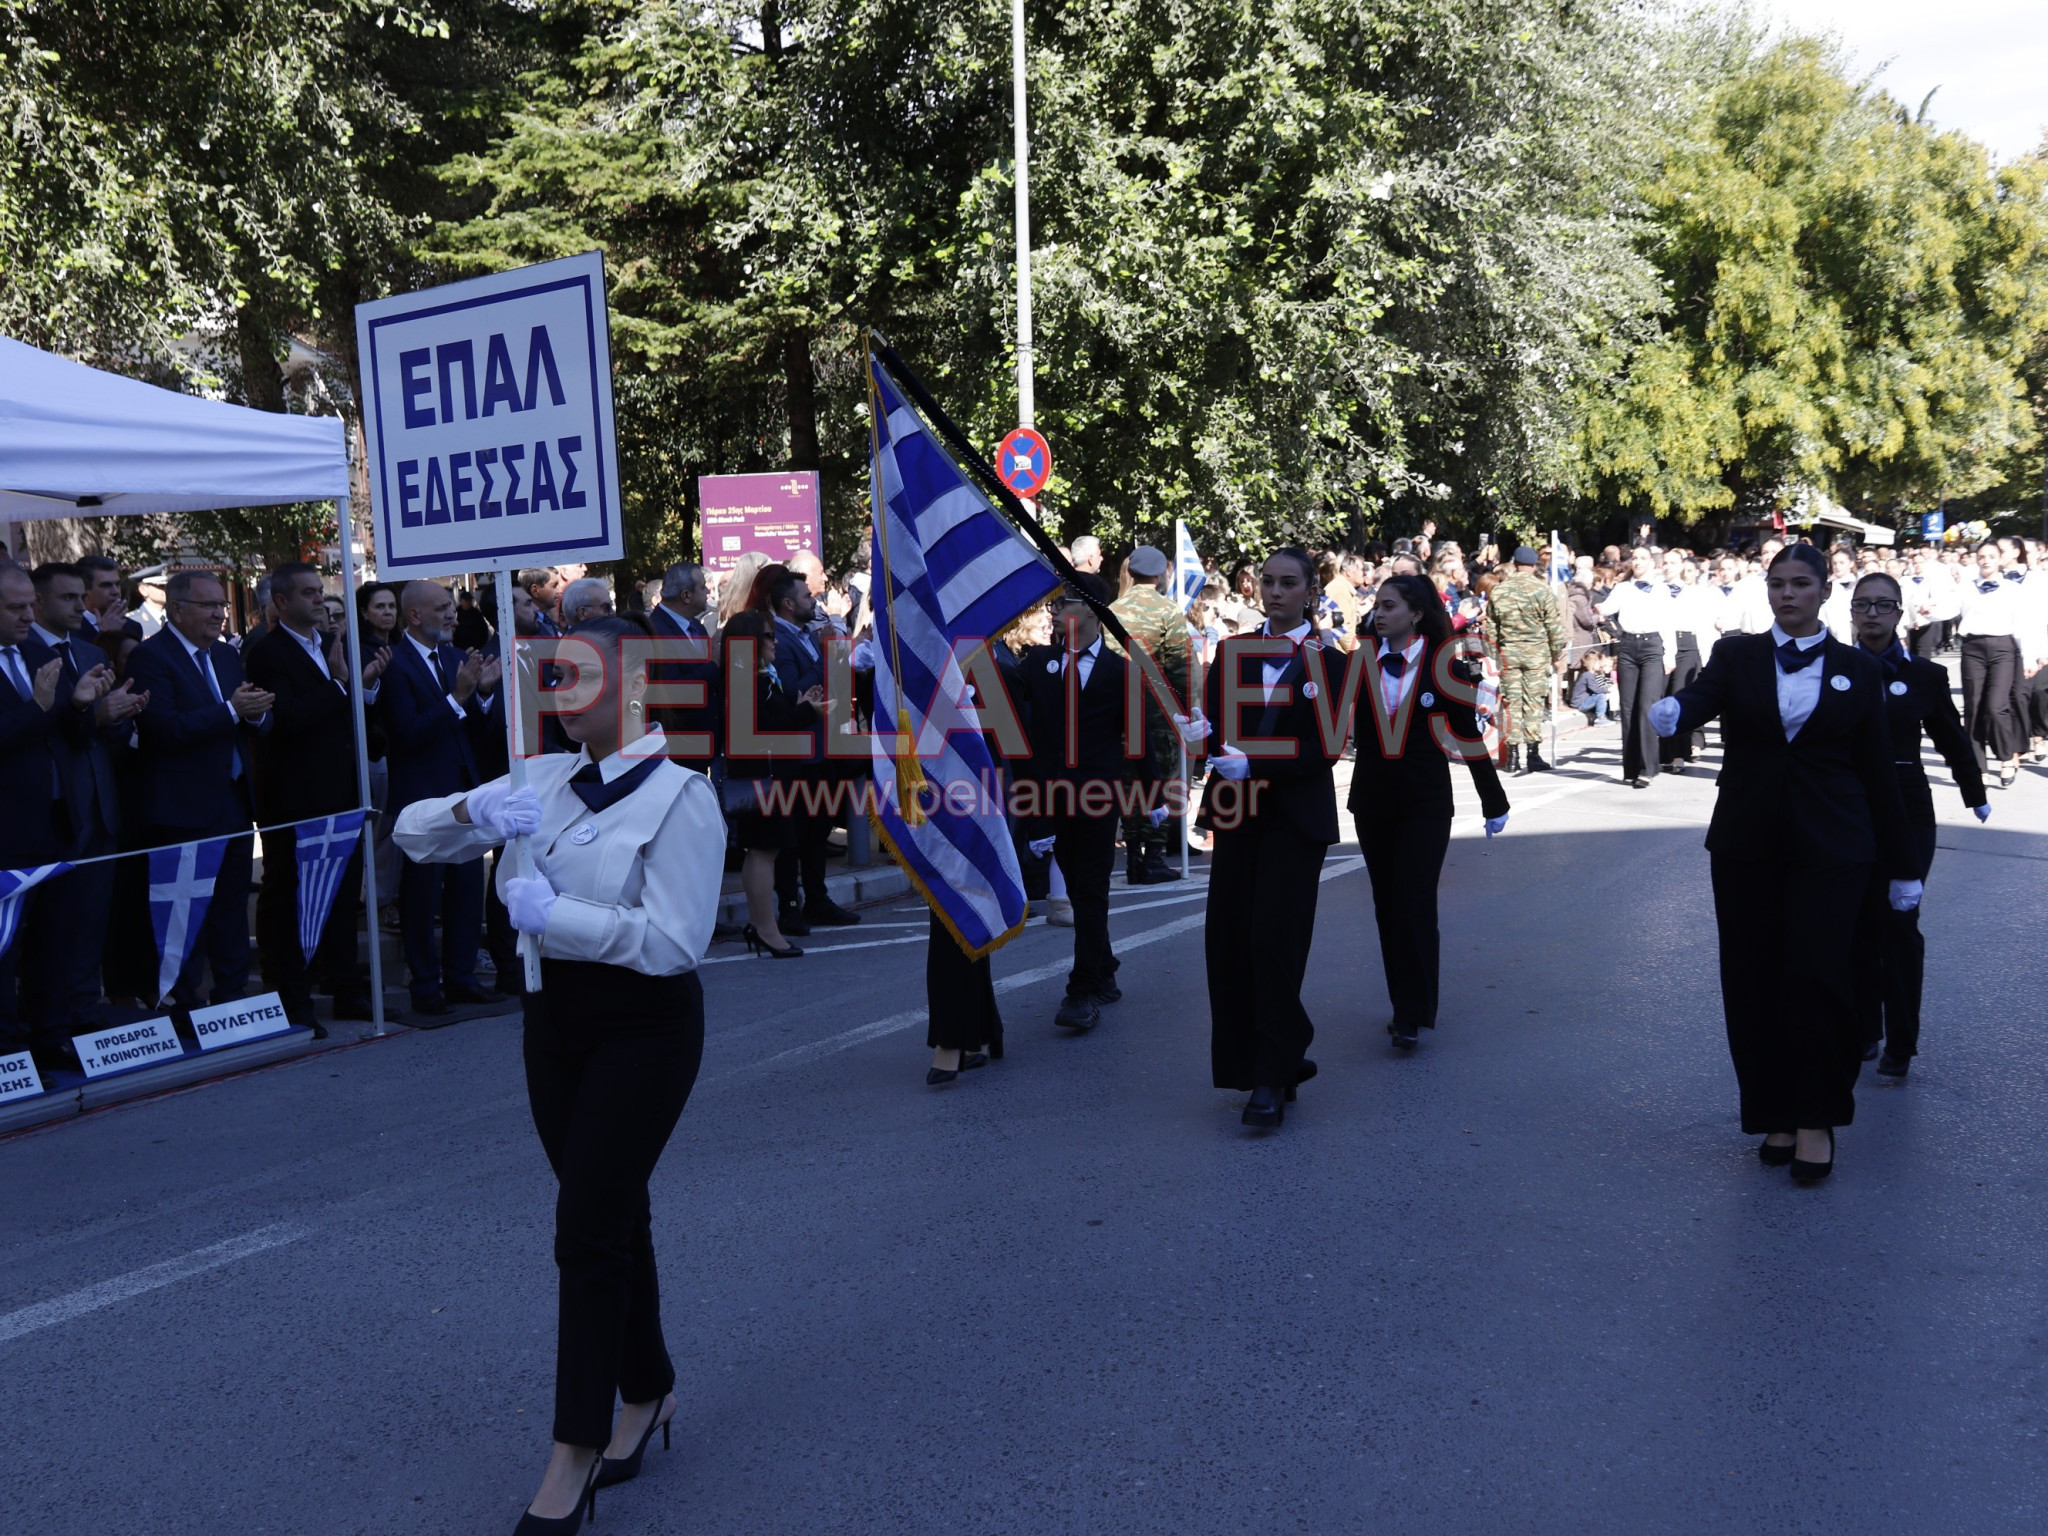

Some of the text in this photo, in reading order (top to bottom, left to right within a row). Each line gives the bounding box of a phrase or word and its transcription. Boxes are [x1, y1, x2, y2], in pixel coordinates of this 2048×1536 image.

[399, 324, 567, 430] ΕΠΑΛ
[397, 435, 587, 528] ΕΔΕΣΣΑΣ
[197, 1005, 284, 1037] ΒΟΥΛΕΥΤΕΣ
[86, 1038, 177, 1070] Τ. ΚΟΙΝΟΤΗΤΑΣ
[94, 1026, 158, 1051] ΠΡΟΕΔΡΟΣ
[0, 1076, 34, 1094] ΣΗΣ
